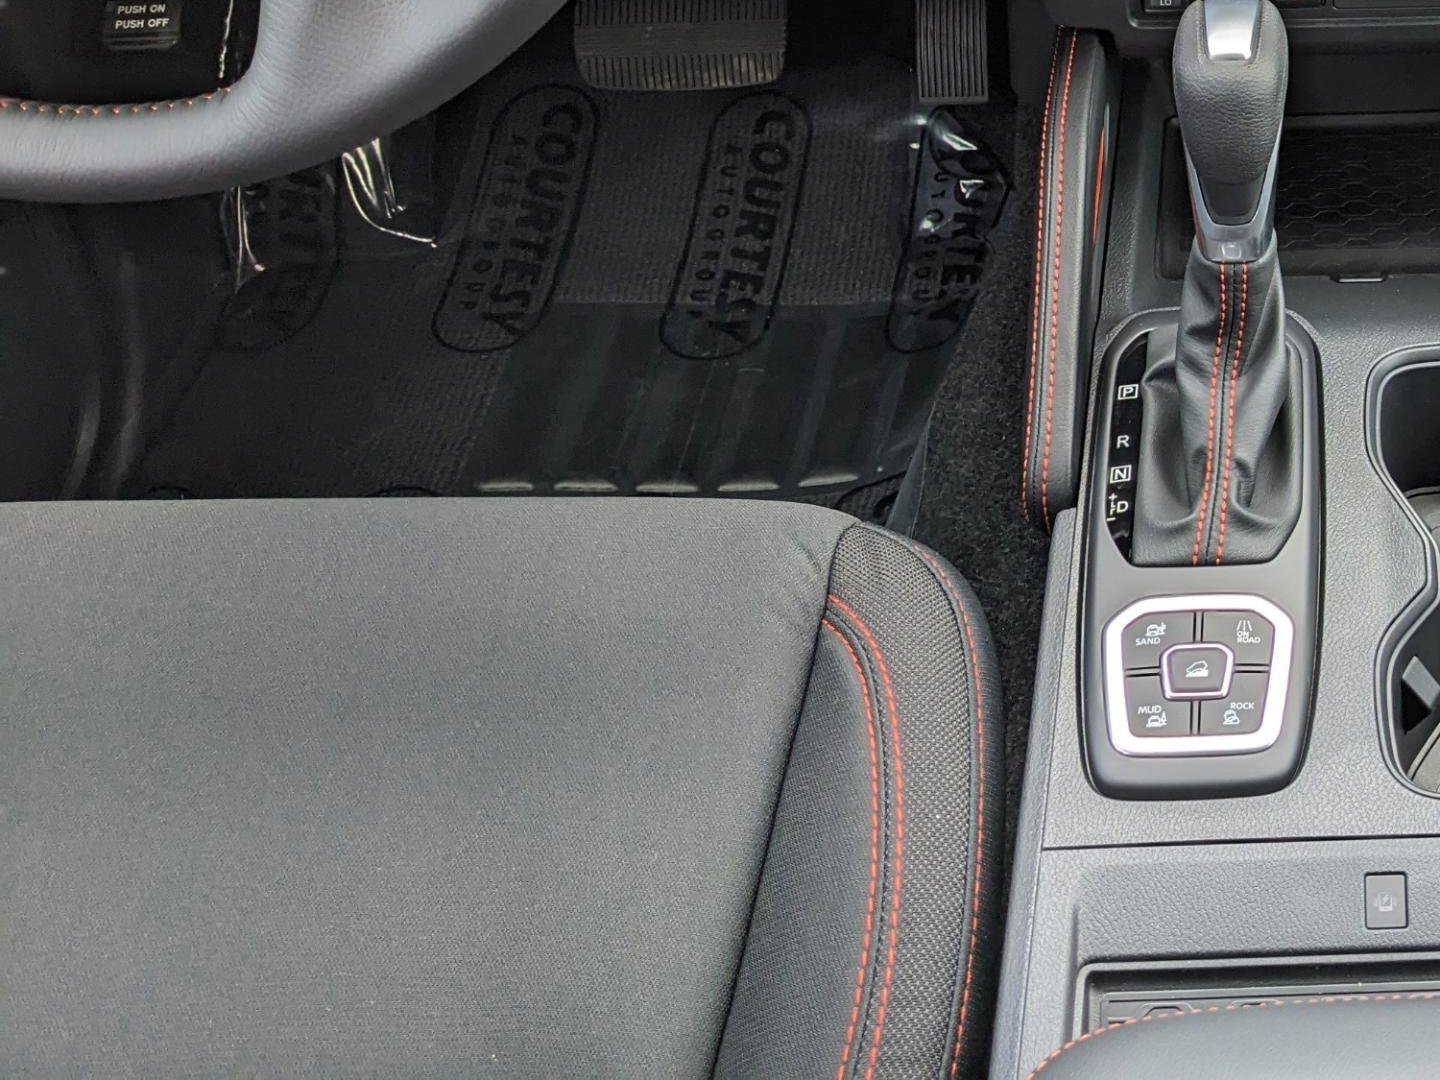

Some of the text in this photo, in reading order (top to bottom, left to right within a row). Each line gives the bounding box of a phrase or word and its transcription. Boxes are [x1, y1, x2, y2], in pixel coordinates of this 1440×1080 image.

[118, 4, 166, 15] PUSH ON
[115, 18, 170, 30] PUSH OFF
[482, 103, 583, 336] COURTESY
[707, 110, 796, 344] COURTESY
[1116, 435, 1130, 449] R
[1114, 468, 1128, 480] N
[1116, 501, 1129, 513] D
[1236, 630, 1249, 638] ON
[1135, 637, 1161, 646] SAND
[1236, 636, 1261, 644] ROAD
[1138, 706, 1162, 715] MUD
[1230, 702, 1255, 710] ROCK
